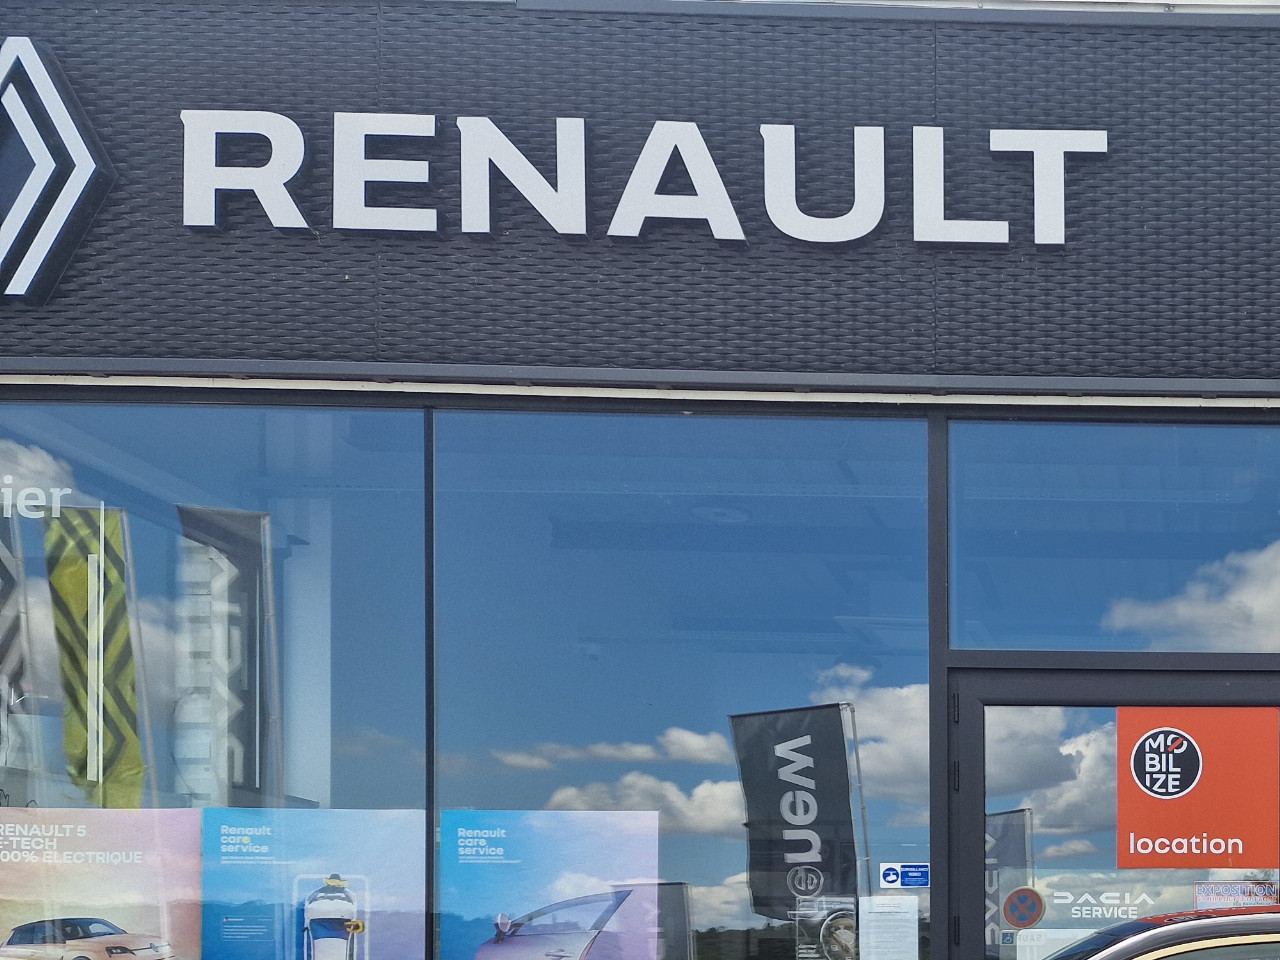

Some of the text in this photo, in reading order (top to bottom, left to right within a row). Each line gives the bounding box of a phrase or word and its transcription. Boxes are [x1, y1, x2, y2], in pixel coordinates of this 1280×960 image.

[180, 109, 1108, 246] RENAULT
[76, 825, 87, 837] 5
[220, 825, 272, 836] Renault
[457, 827, 507, 838] Renault
[220, 836, 251, 844] care
[457, 838, 487, 846] care
[1129, 832, 1244, 854] location
[220, 843, 269, 853] service
[457, 845, 504, 855] service
[1196, 884, 1277, 896] EXPOSITION
[1053, 891, 1156, 905] DACIA
[1071, 906, 1138, 919] SERVICE
